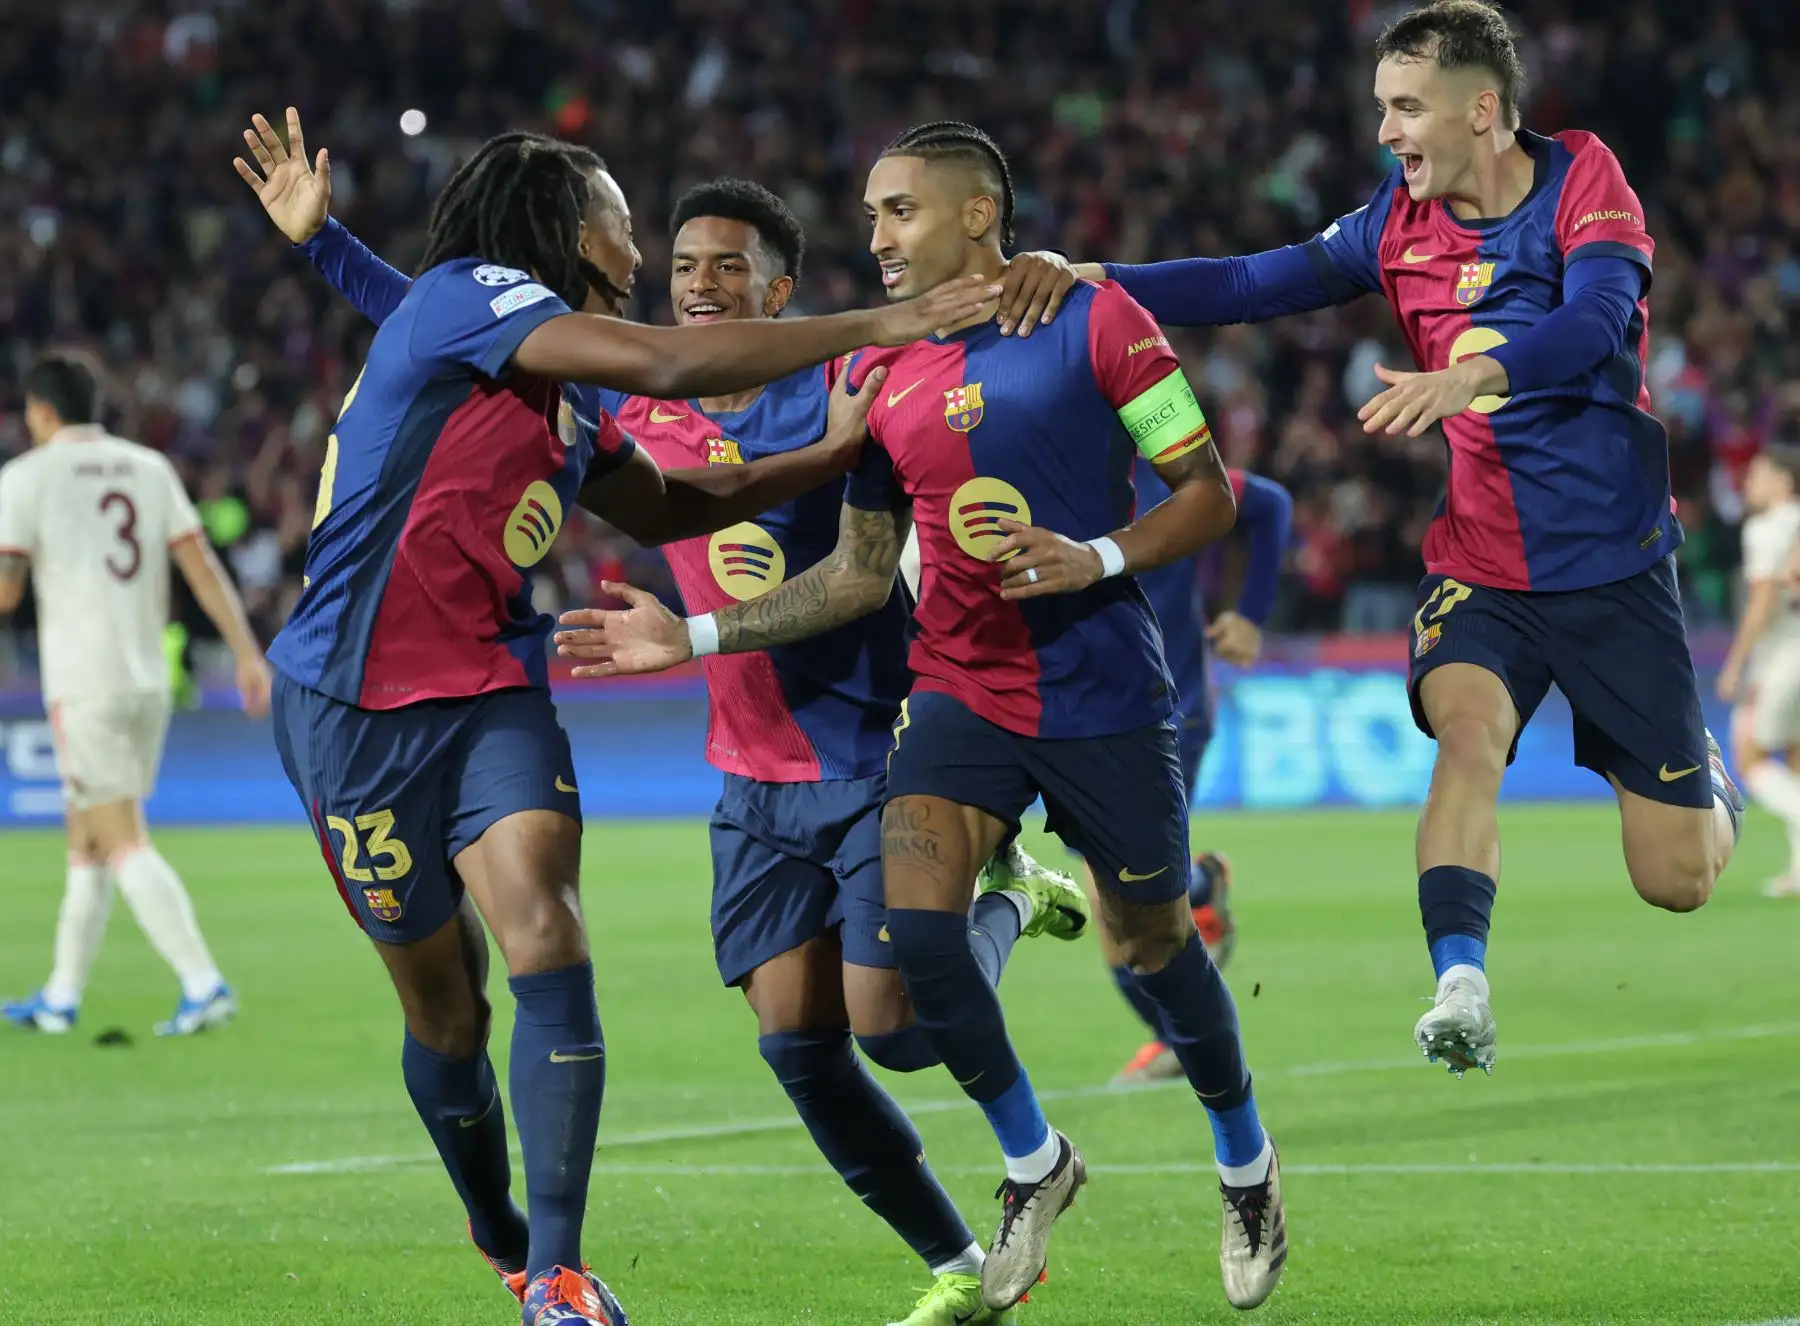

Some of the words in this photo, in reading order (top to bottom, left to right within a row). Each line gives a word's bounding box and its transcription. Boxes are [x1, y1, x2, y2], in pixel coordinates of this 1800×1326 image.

[1574, 210, 1631, 232] AMBILIGHT
[957, 404, 972, 413] FCB
[1130, 403, 1175, 439] RESPECT
[99, 490, 141, 582] 3
[326, 809, 413, 882] 23
